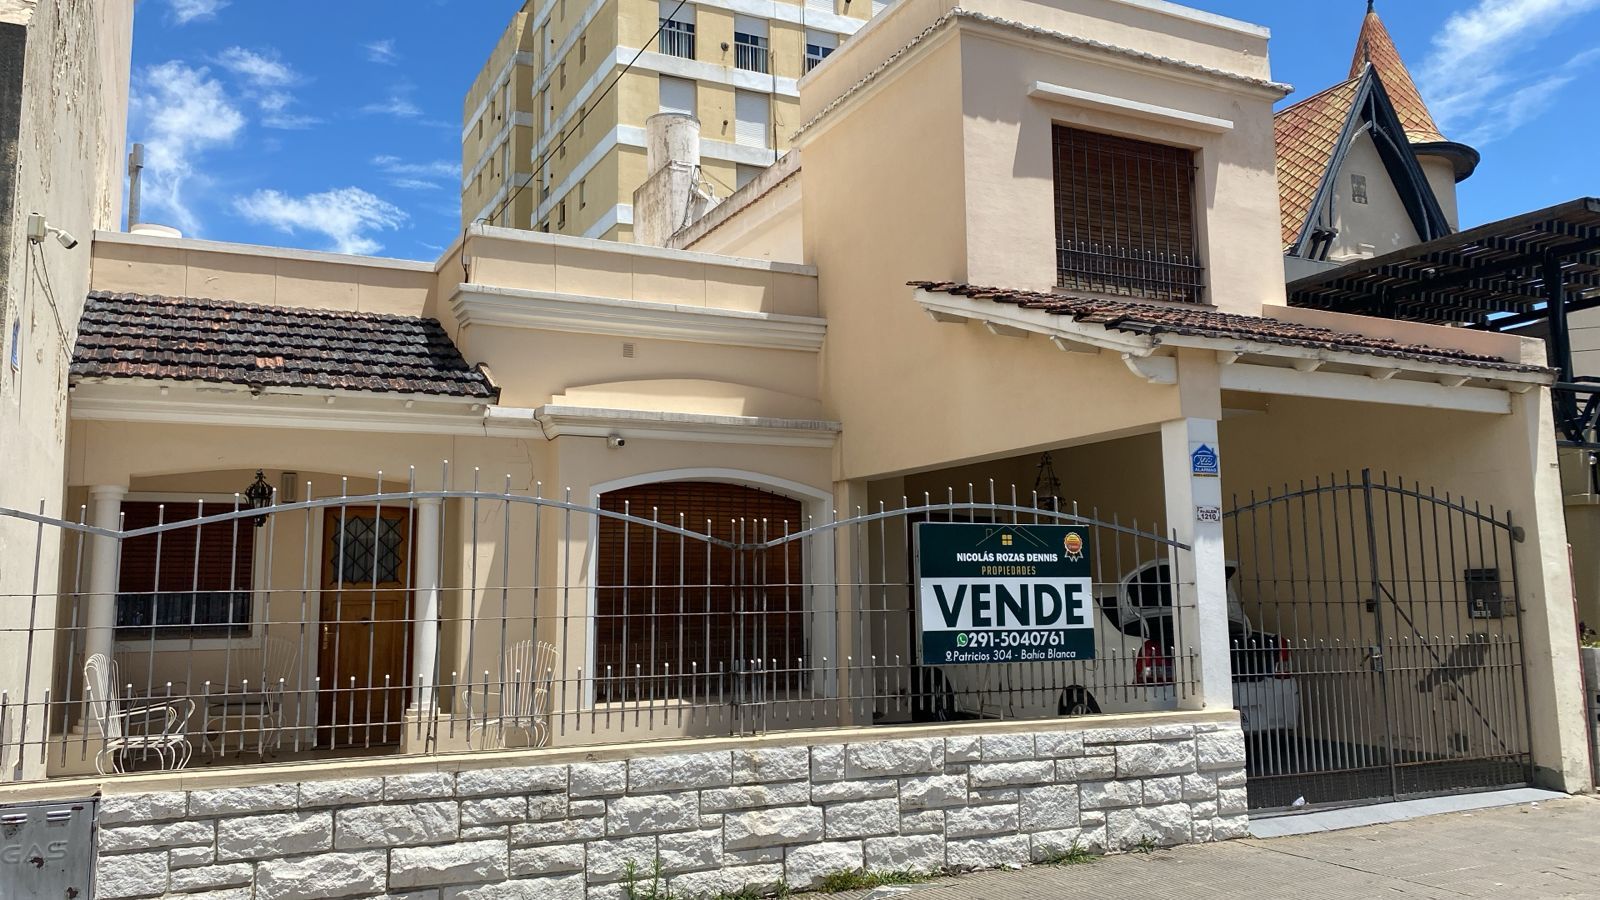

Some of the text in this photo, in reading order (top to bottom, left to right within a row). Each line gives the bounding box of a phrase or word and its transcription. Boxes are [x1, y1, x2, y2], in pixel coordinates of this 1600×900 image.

[956, 551, 1058, 562] NICOLÁS ROZAS DENNIS
[981, 565, 1037, 576] PROPIEDADES
[932, 583, 1085, 628] VENDE
[969, 631, 1065, 648] 291-5040761
[953, 650, 991, 662] Patricios
[993, 649, 1013, 661] 304
[1021, 649, 1046, 660] Bahía
[1048, 648, 1076, 659] Blanca
[1, 840, 69, 864] GAS
